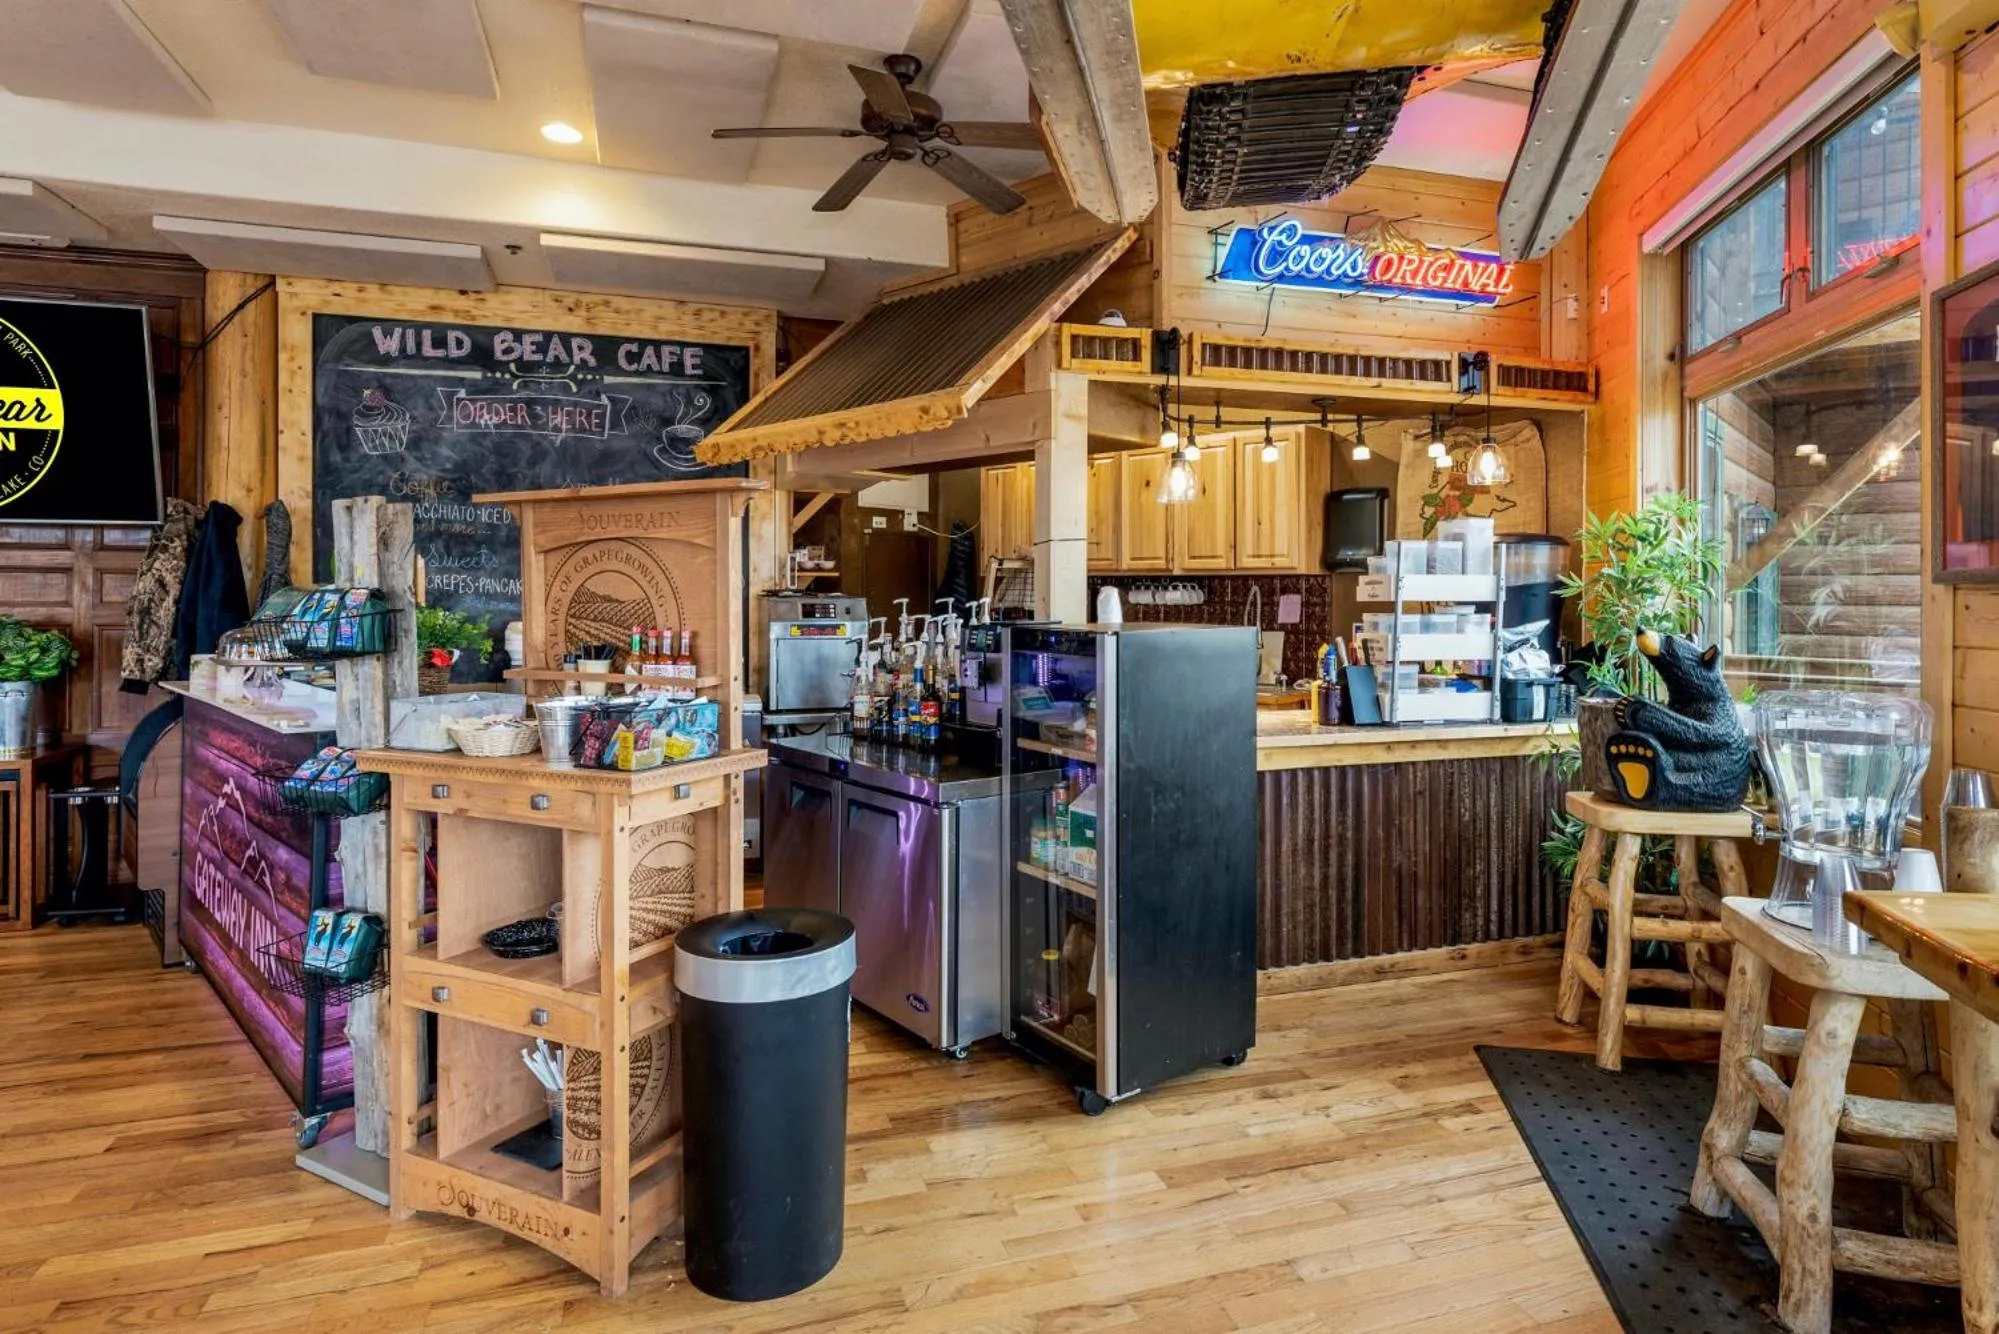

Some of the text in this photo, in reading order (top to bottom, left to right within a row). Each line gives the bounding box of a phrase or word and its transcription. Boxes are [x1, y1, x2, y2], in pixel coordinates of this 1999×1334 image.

[1253, 219, 1514, 293] Coors ORIGINAL
[3, 331, 33, 359] PARK
[371, 325, 704, 376] WILD BEAR CAFE
[457, 400, 603, 434] ORDER HERE
[28, 455, 45, 471] CO
[426, 543, 499, 568] Sweets
[559, 573, 573, 592] OF
[573, 548, 666, 608] GRAPEGROWING
[195, 851, 278, 985] GATEWAY INN
[437, 1176, 561, 1242] SOUVERAIN
